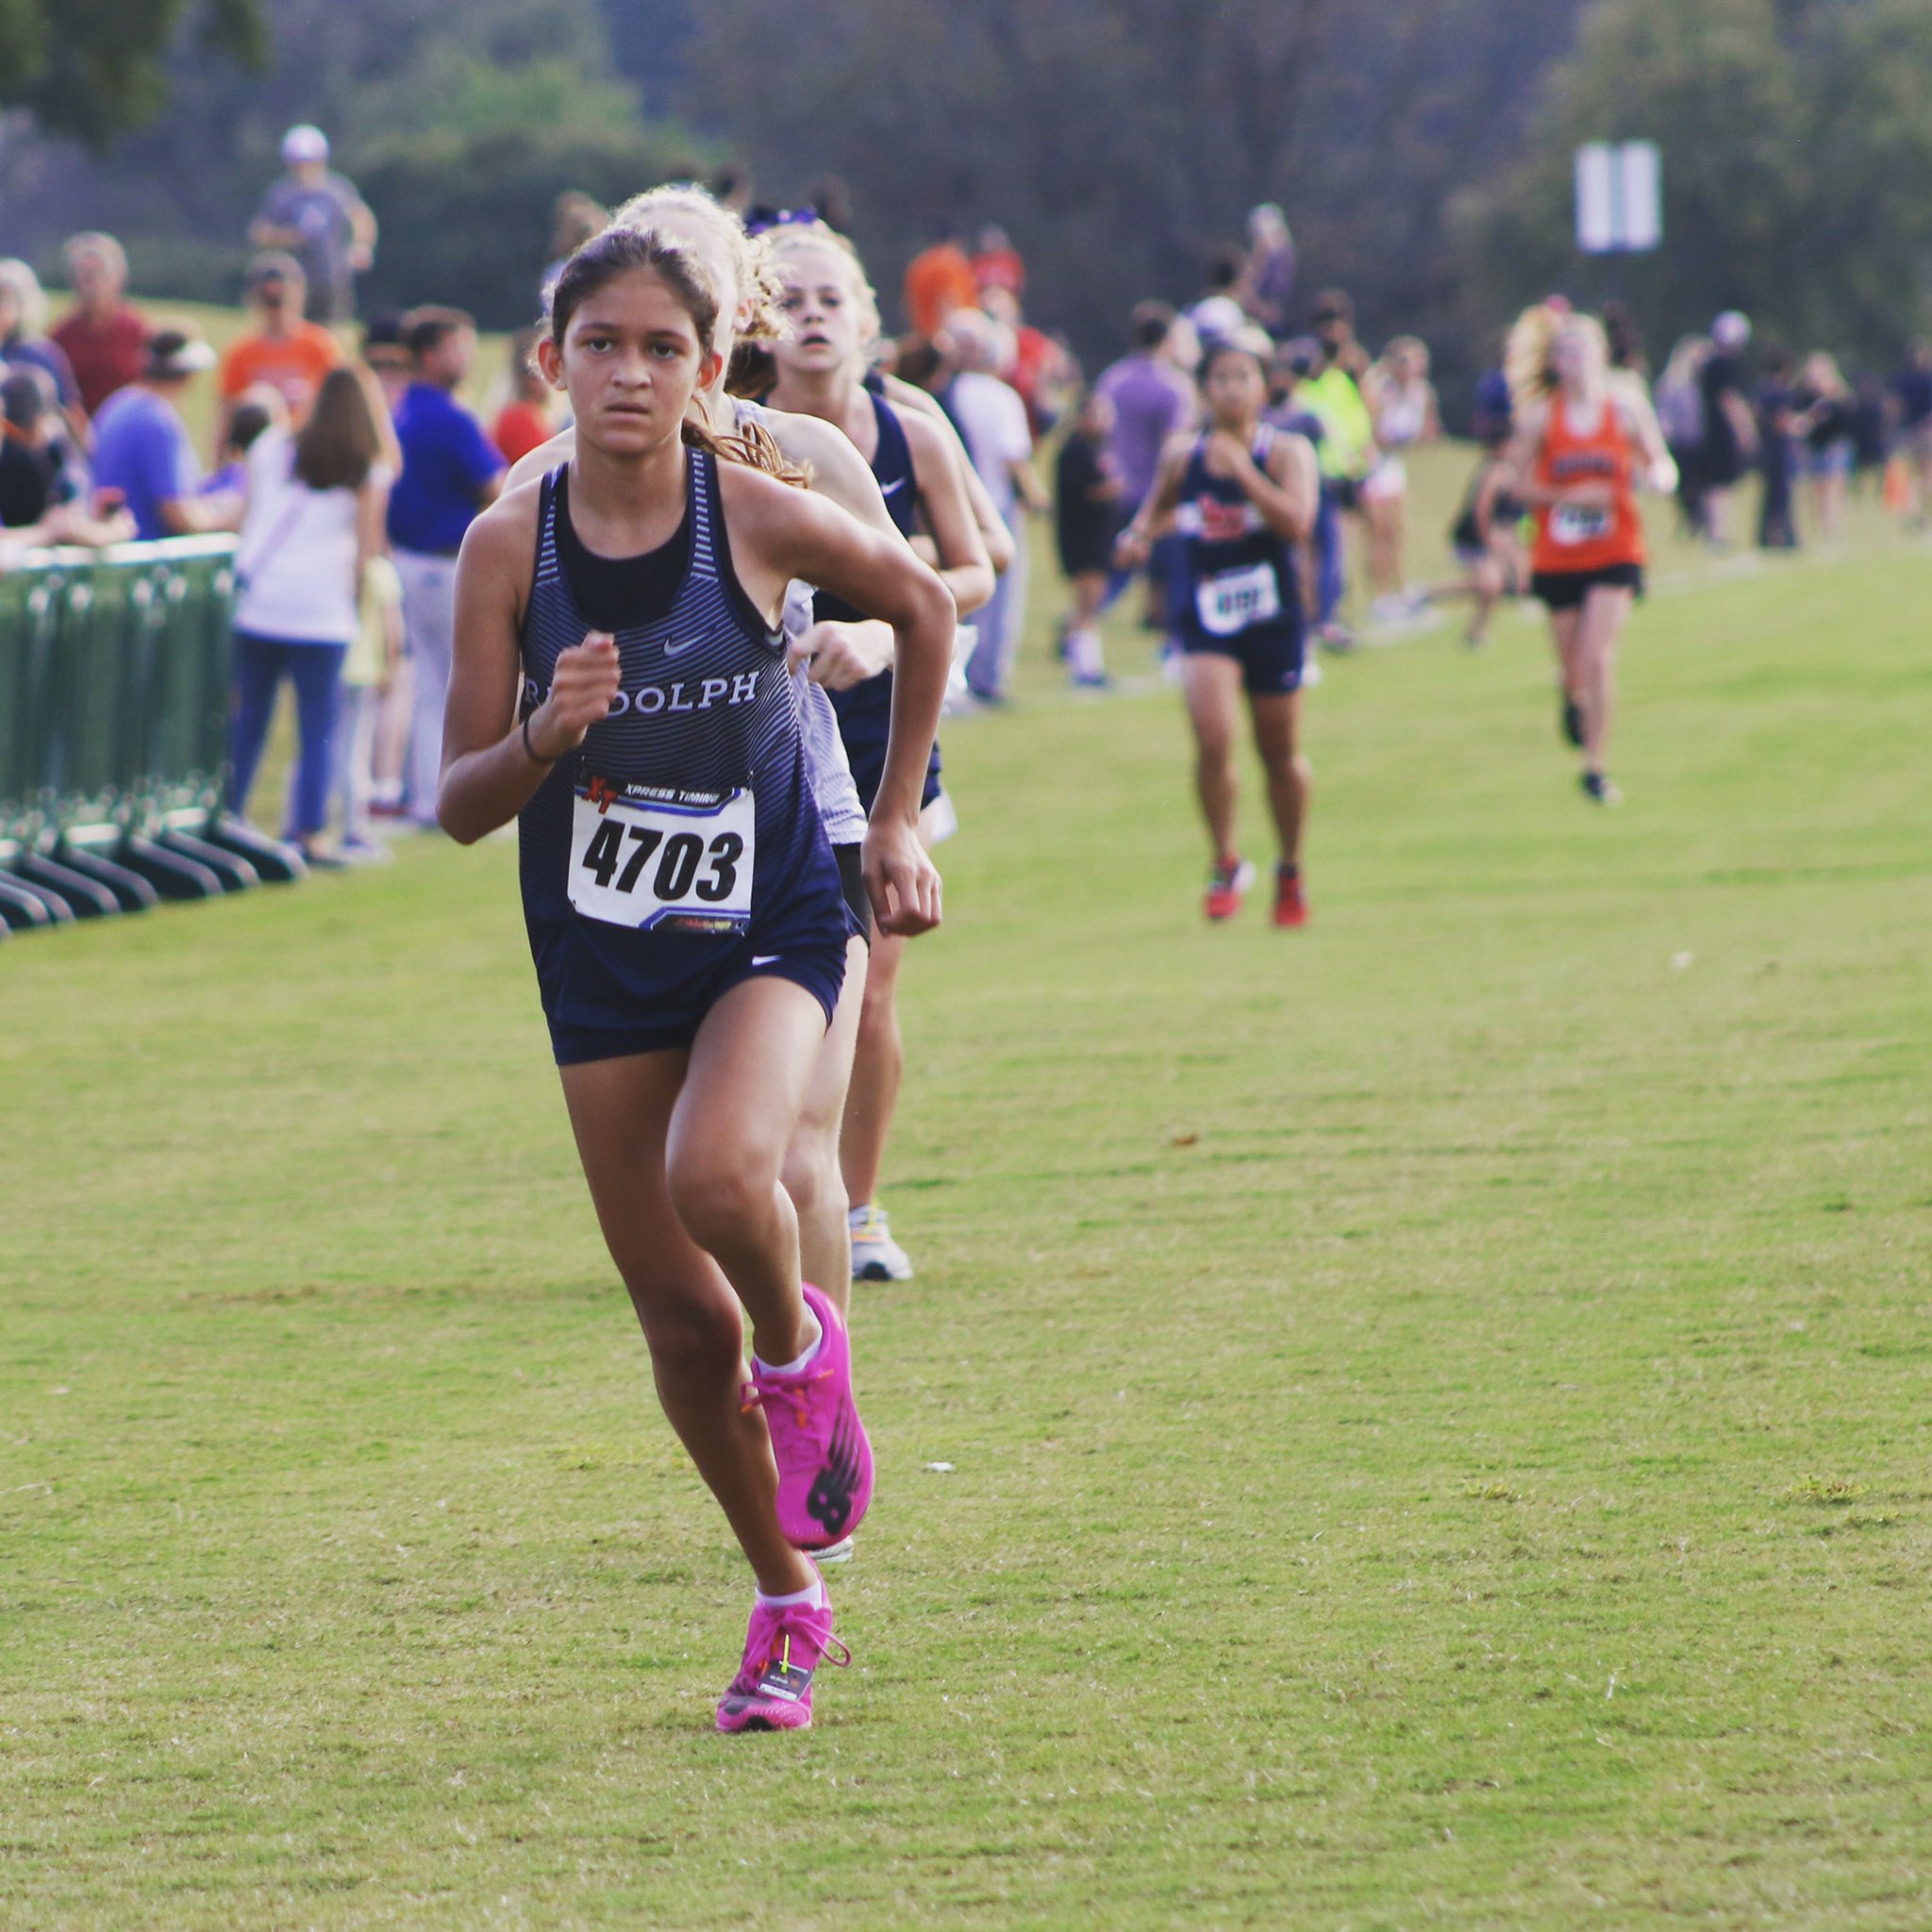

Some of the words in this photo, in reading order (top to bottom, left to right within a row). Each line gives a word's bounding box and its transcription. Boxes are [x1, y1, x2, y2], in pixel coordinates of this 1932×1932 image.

[525, 670, 760, 718] RDOLPH
[625, 783, 676, 801] XPRESS
[582, 817, 743, 902] 4703
